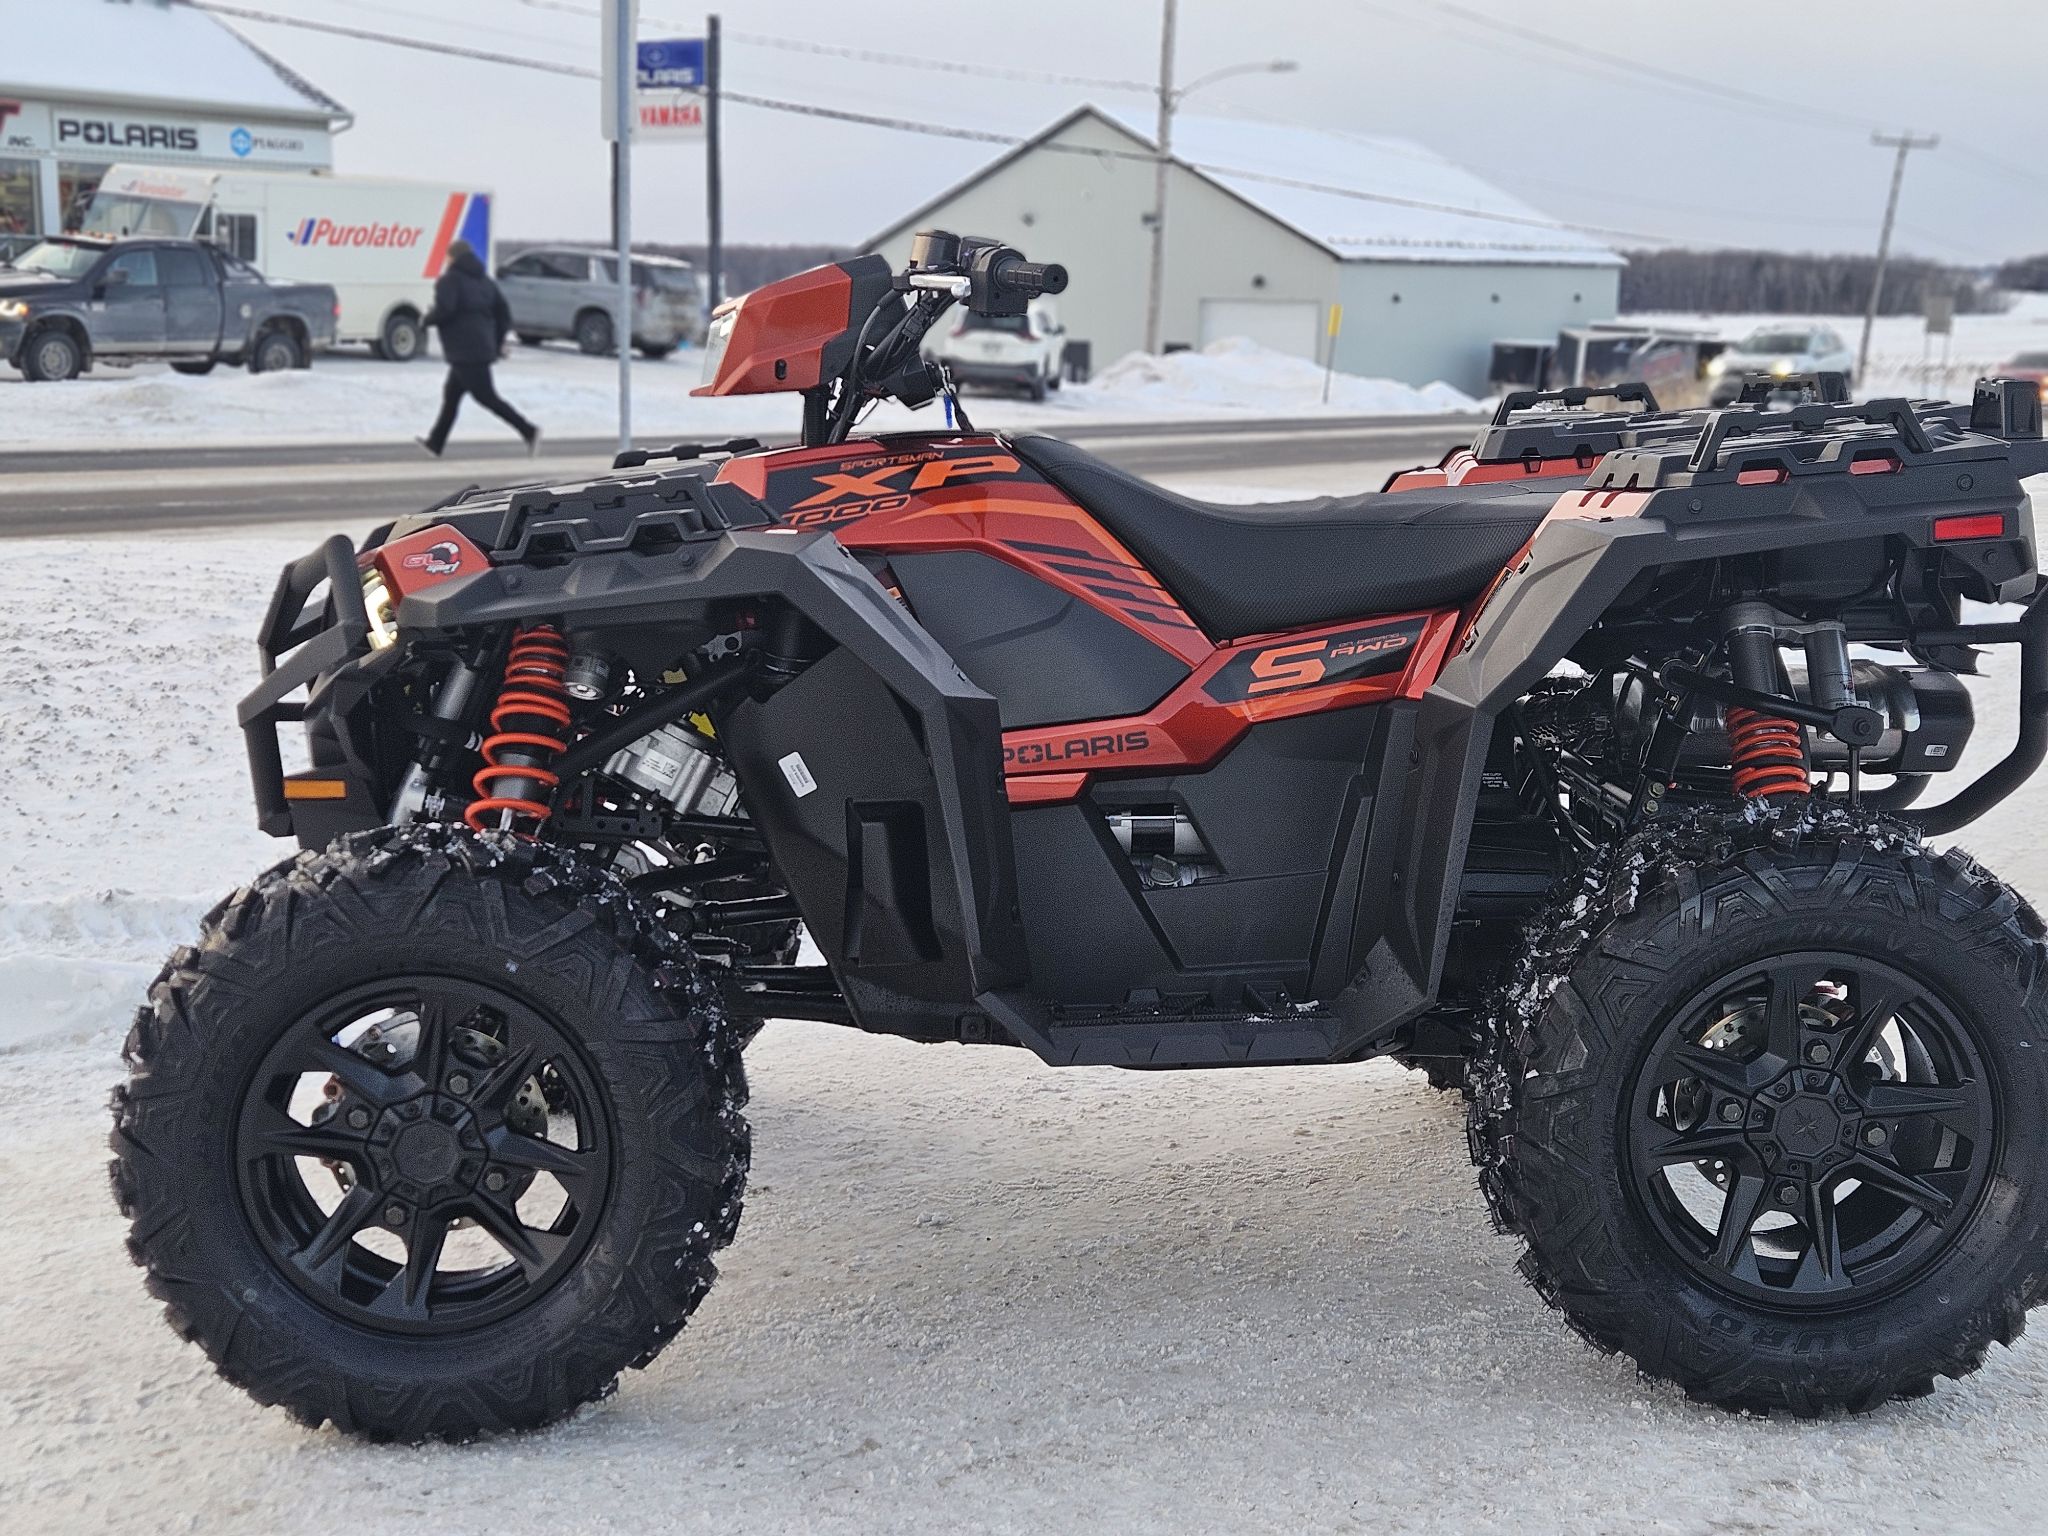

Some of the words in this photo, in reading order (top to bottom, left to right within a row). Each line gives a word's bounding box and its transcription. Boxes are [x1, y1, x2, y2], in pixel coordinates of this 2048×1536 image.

[58, 119, 199, 150] POLARIS
[312, 219, 422, 247] Purolator
[839, 451, 945, 471] SPORTSMAN
[789, 455, 1021, 509] XP
[782, 494, 911, 526] 1000
[1330, 636, 1408, 658] AWD
[1247, 640, 1328, 694] S
